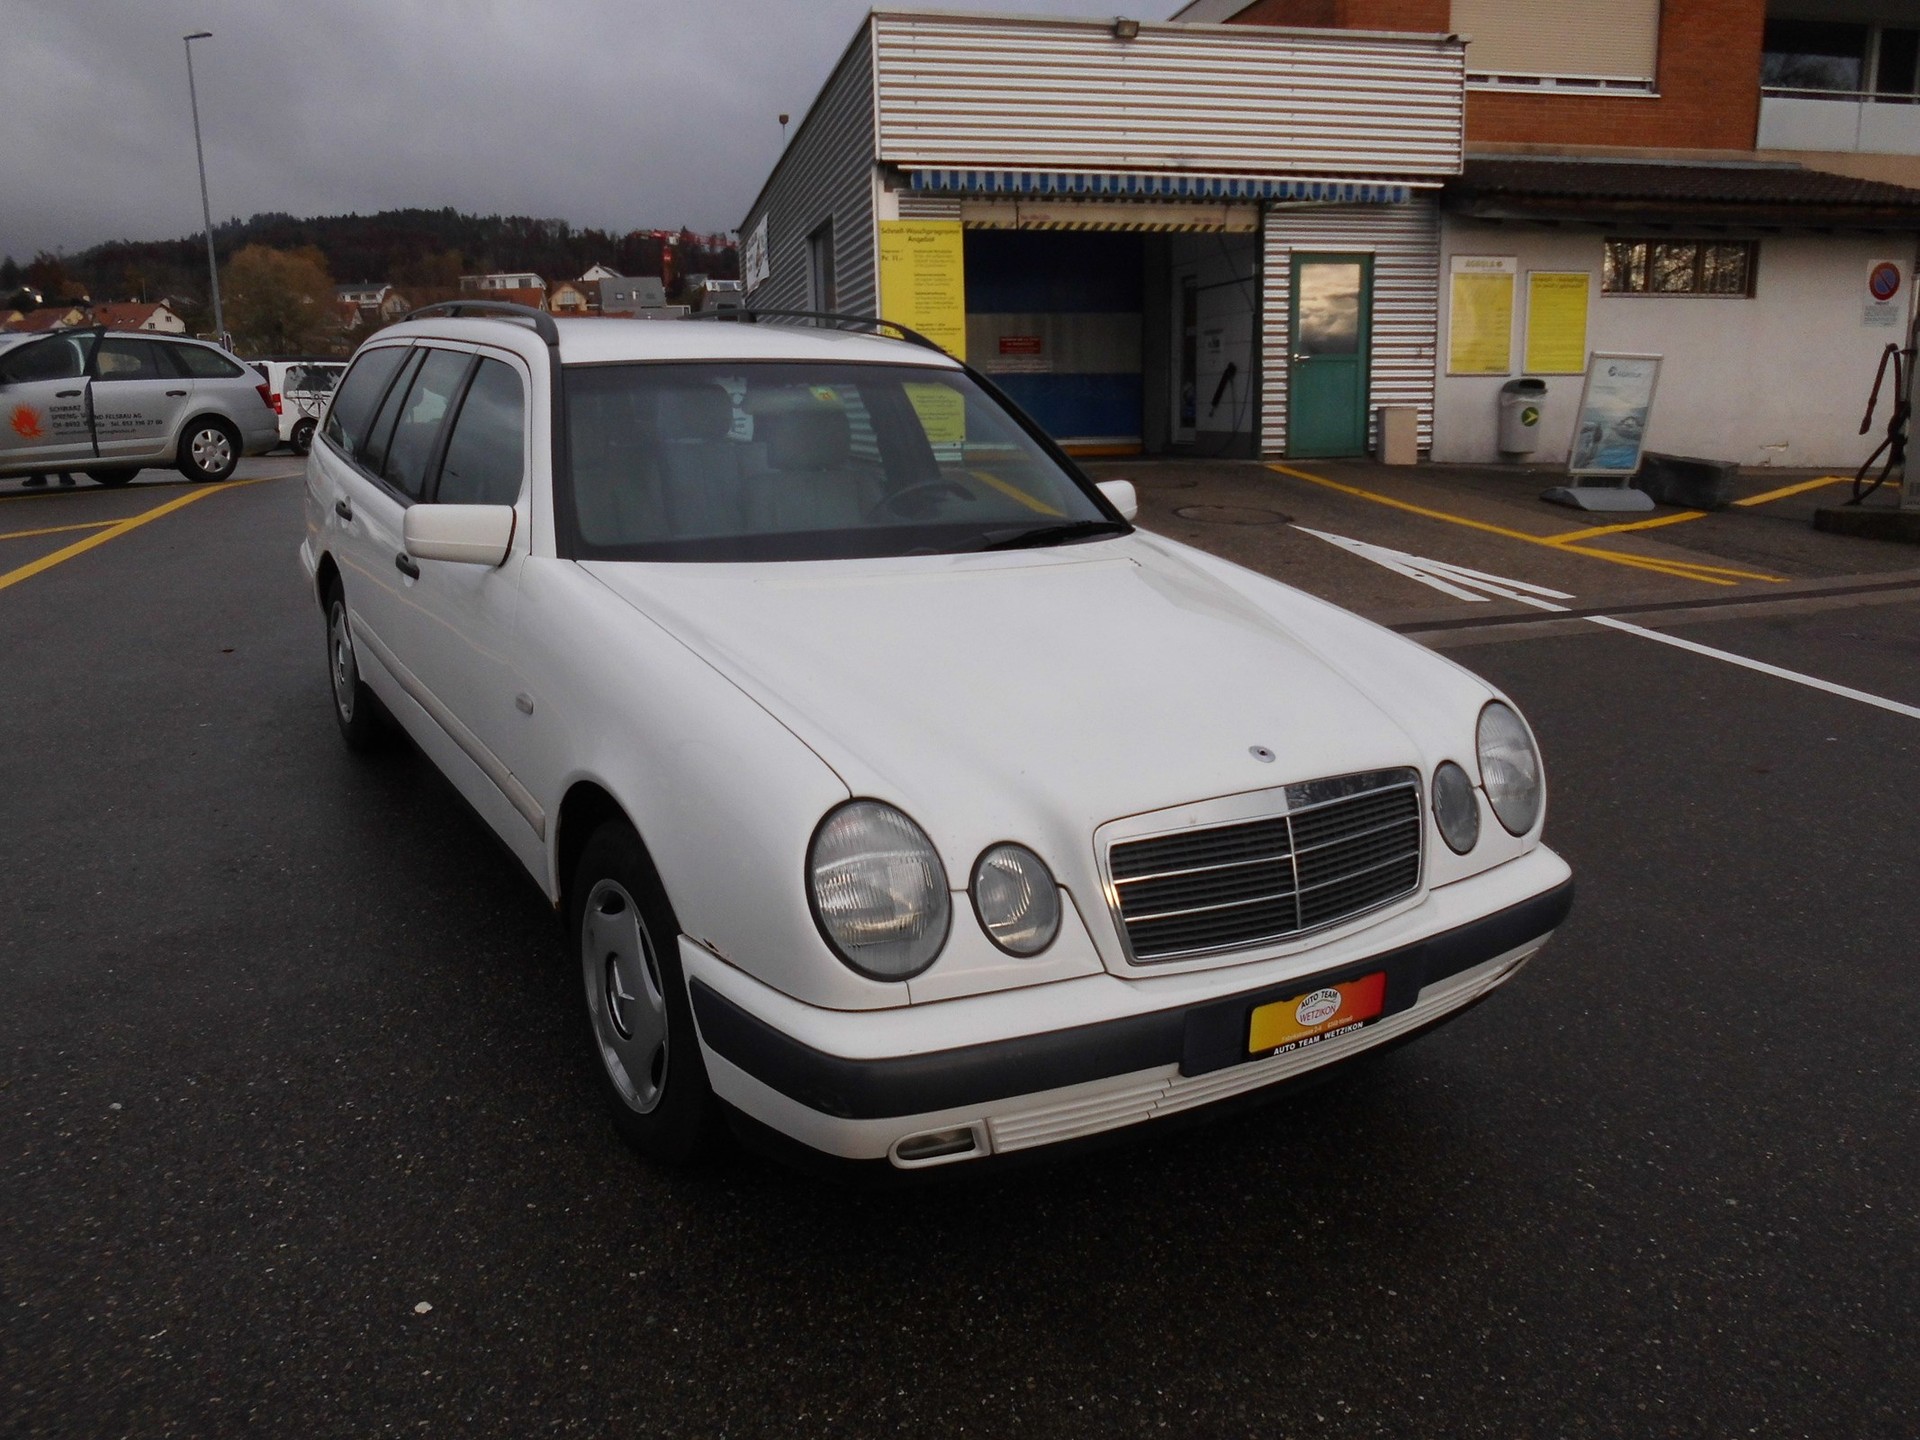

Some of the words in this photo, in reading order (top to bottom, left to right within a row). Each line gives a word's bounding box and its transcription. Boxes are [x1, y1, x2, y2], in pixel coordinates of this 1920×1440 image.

[1301, 993, 1319, 1009] AUTO
[1321, 990, 1338, 999] TEAM
[1300, 1005, 1337, 1022] WETZIKON
[1273, 1043, 1296, 1056] AUTO
[1298, 1035, 1320, 1047] TEAM
[1324, 1021, 1364, 1039] WETZIKON
